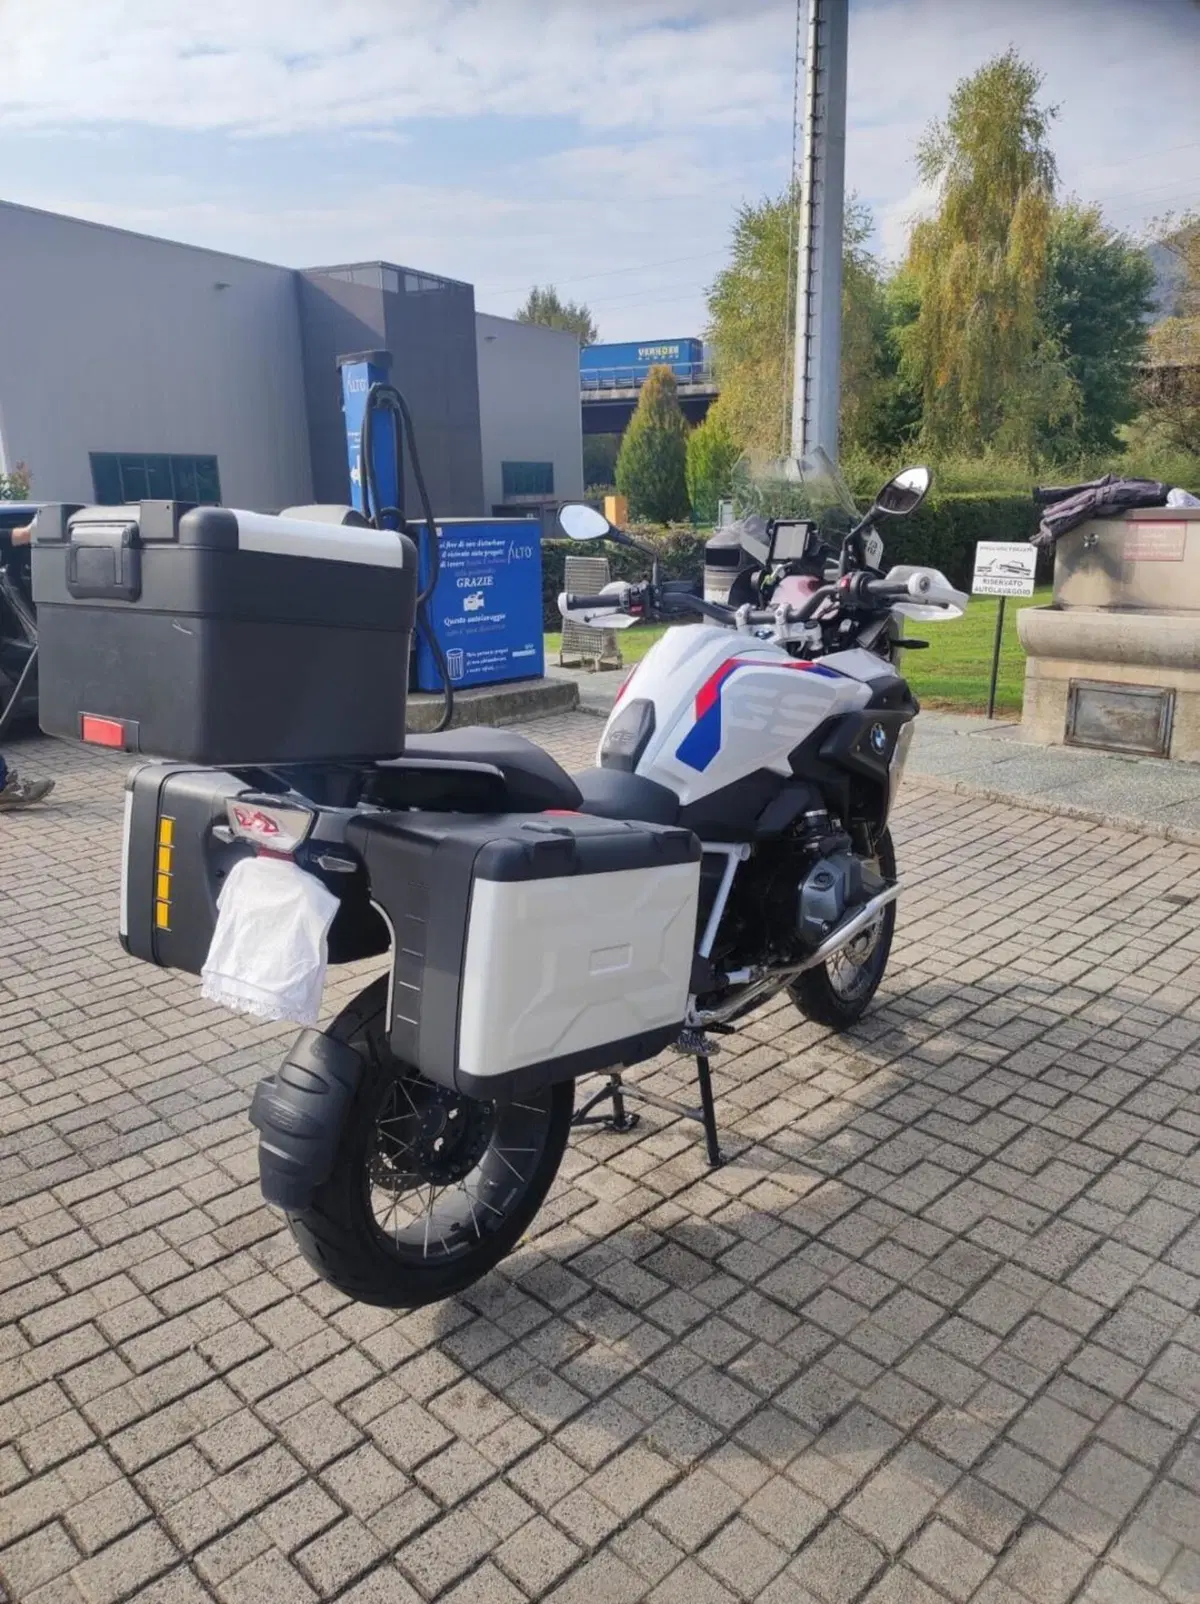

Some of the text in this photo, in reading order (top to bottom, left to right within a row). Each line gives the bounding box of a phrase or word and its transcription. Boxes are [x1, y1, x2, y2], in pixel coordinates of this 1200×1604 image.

[507, 539, 533, 565] ALTO
[455, 576, 495, 588] GRAZIE
[982, 578, 1024, 587] RISERVATO
